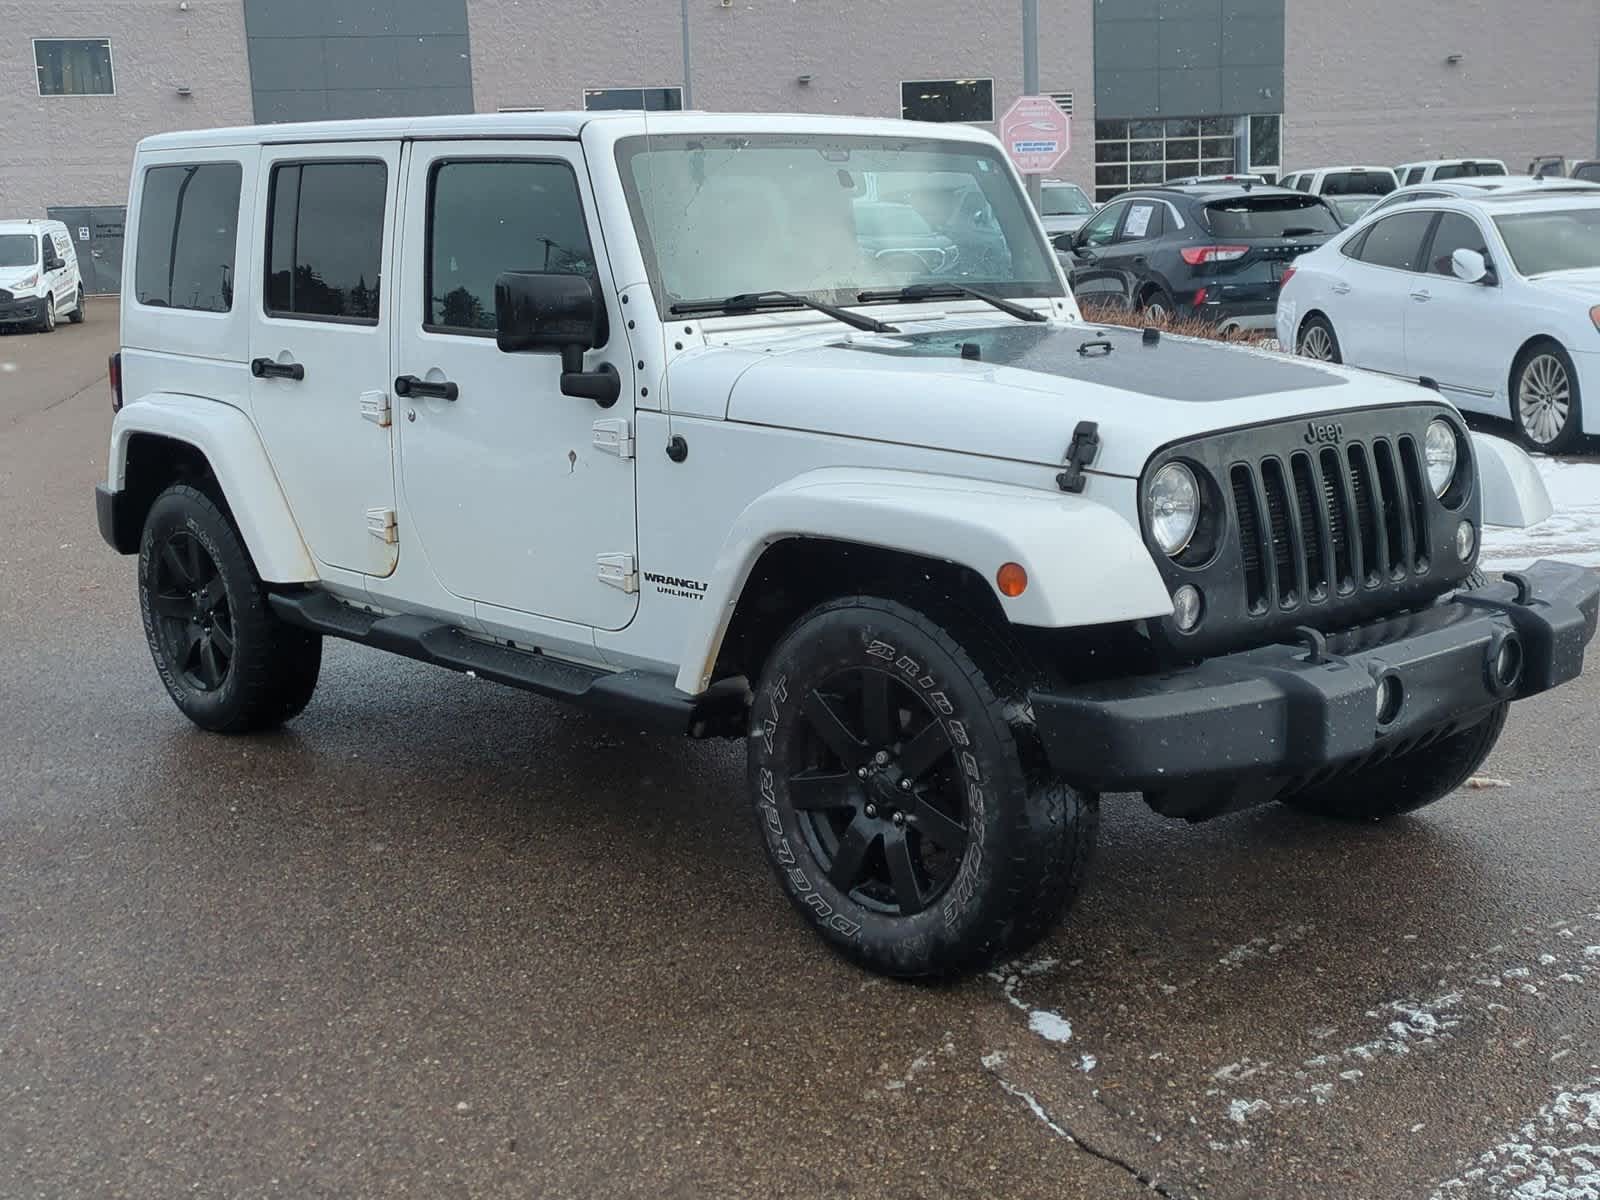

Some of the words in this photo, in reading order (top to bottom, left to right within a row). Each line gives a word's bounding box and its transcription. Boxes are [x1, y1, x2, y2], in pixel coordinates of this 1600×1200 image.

[1304, 421, 1345, 445] Jeep
[761, 674, 789, 755] A/T
[864, 638, 985, 928] BRIDGESTONE
[758, 767, 862, 937] DUELER
